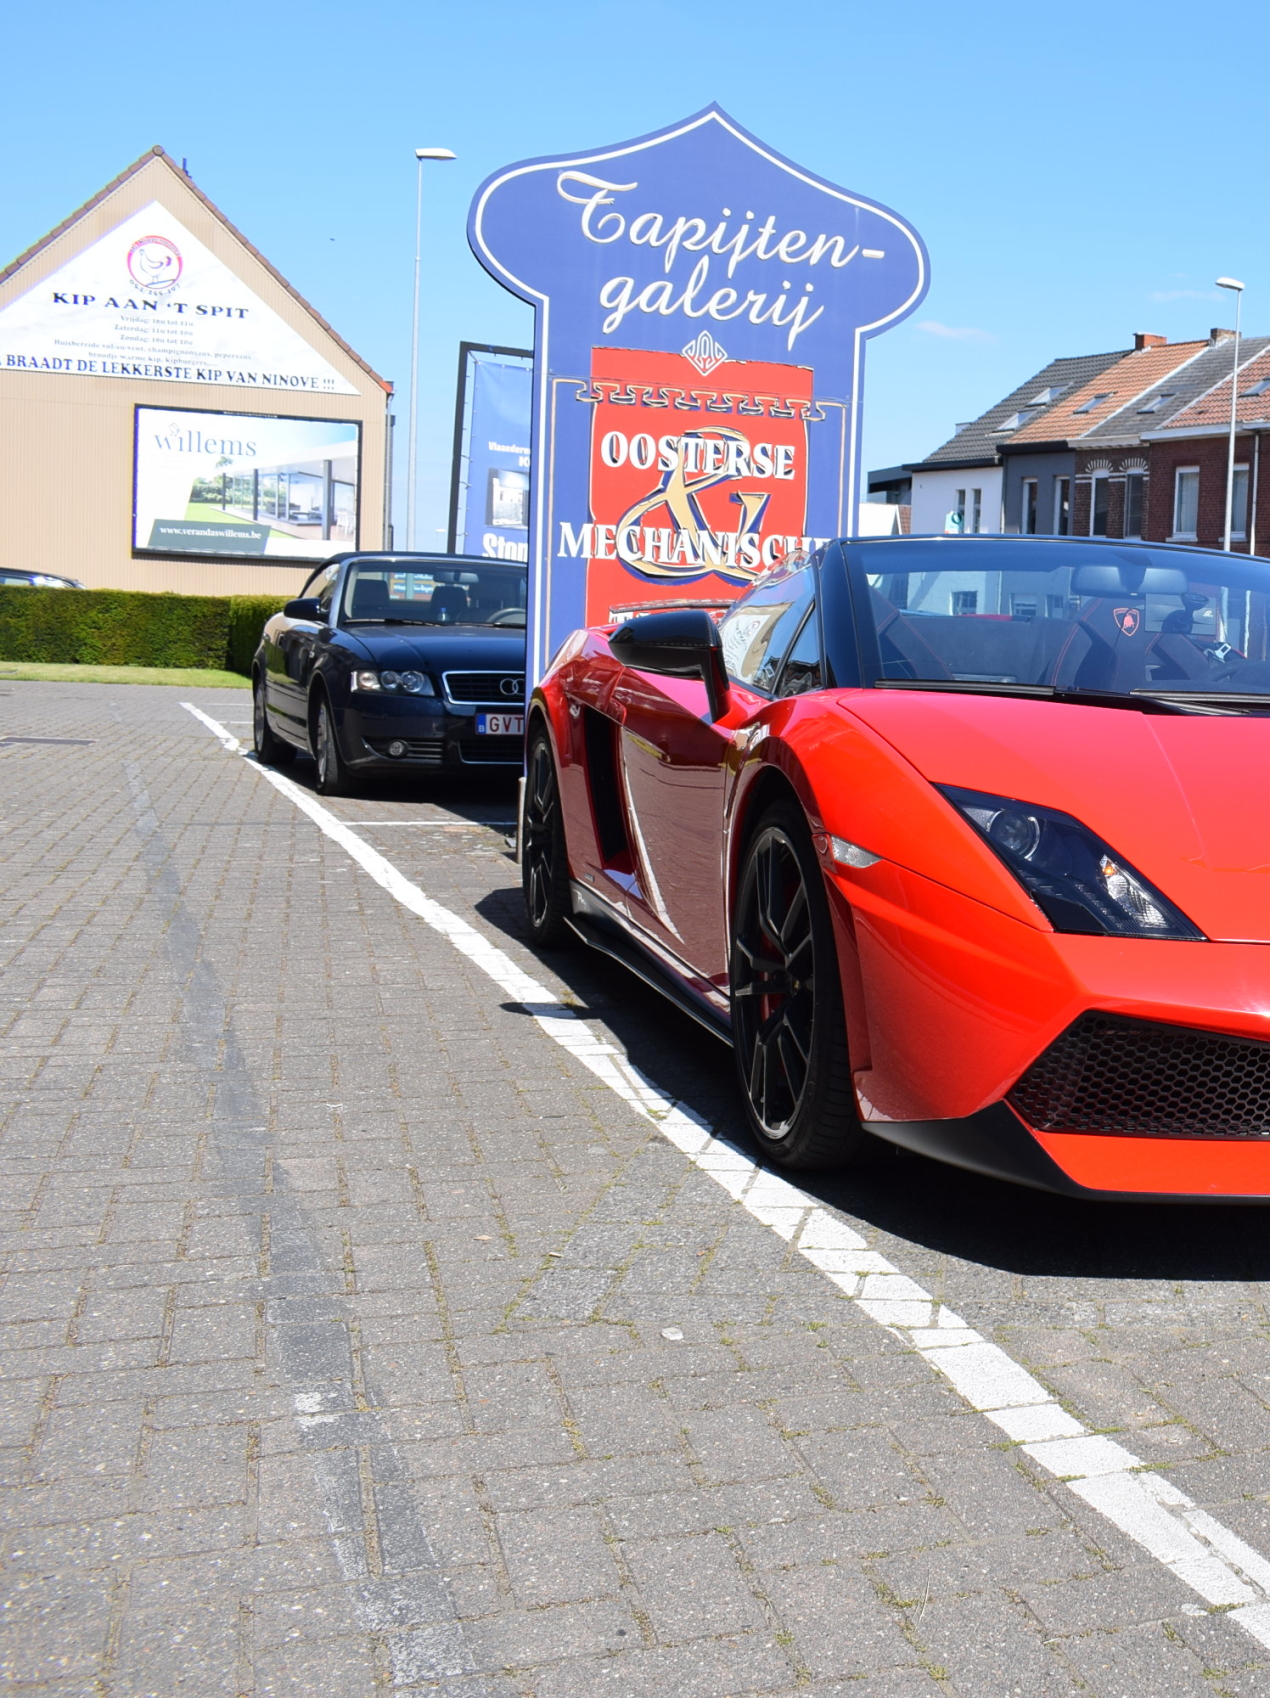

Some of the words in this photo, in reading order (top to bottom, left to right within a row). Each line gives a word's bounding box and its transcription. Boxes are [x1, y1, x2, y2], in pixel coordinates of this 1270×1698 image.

[556, 170, 885, 279] Tapijten-
[53, 292, 96, 306] KIP
[104, 297, 158, 312] AAN
[195, 304, 249, 319] SPIT
[599, 255, 825, 351] galerij
[6, 354, 73, 371] BRAADT
[77, 359, 98, 373] DE
[102, 361, 192, 380] LEKKERSTE
[196, 368, 222, 381] KIP
[226, 370, 257, 384] VAN
[262, 373, 320, 389] NINOVE
[154, 429, 257, 457] willems
[600, 431, 796, 480] OOSTERSE
[159, 526, 262, 540] www.verandaswillems.be
